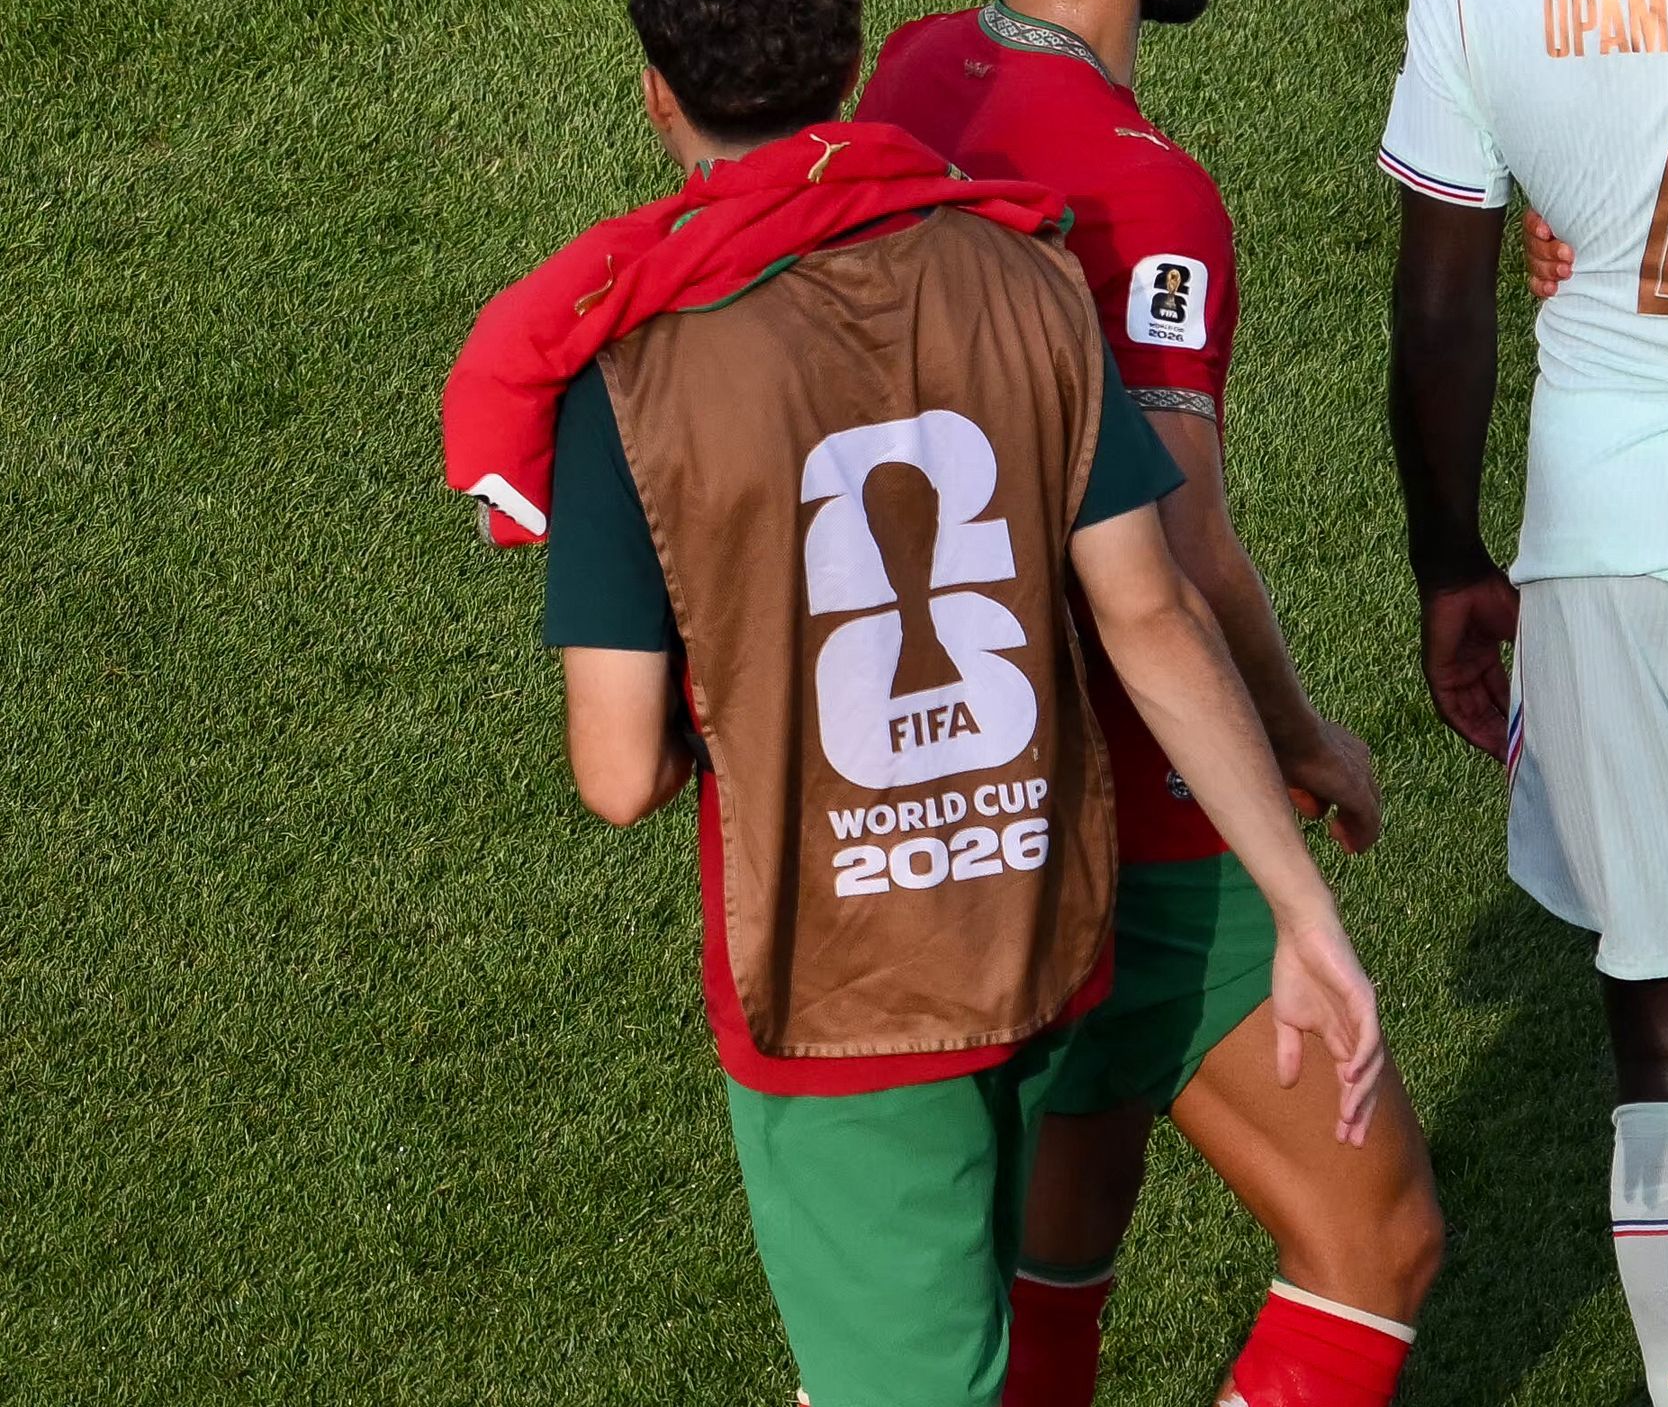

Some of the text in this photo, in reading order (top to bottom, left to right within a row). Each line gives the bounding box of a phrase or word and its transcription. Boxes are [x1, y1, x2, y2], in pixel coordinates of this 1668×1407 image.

[889, 702, 981, 753] FIFA
[828, 777, 1048, 840] WORLD CUP
[832, 818, 1049, 897] 2026
